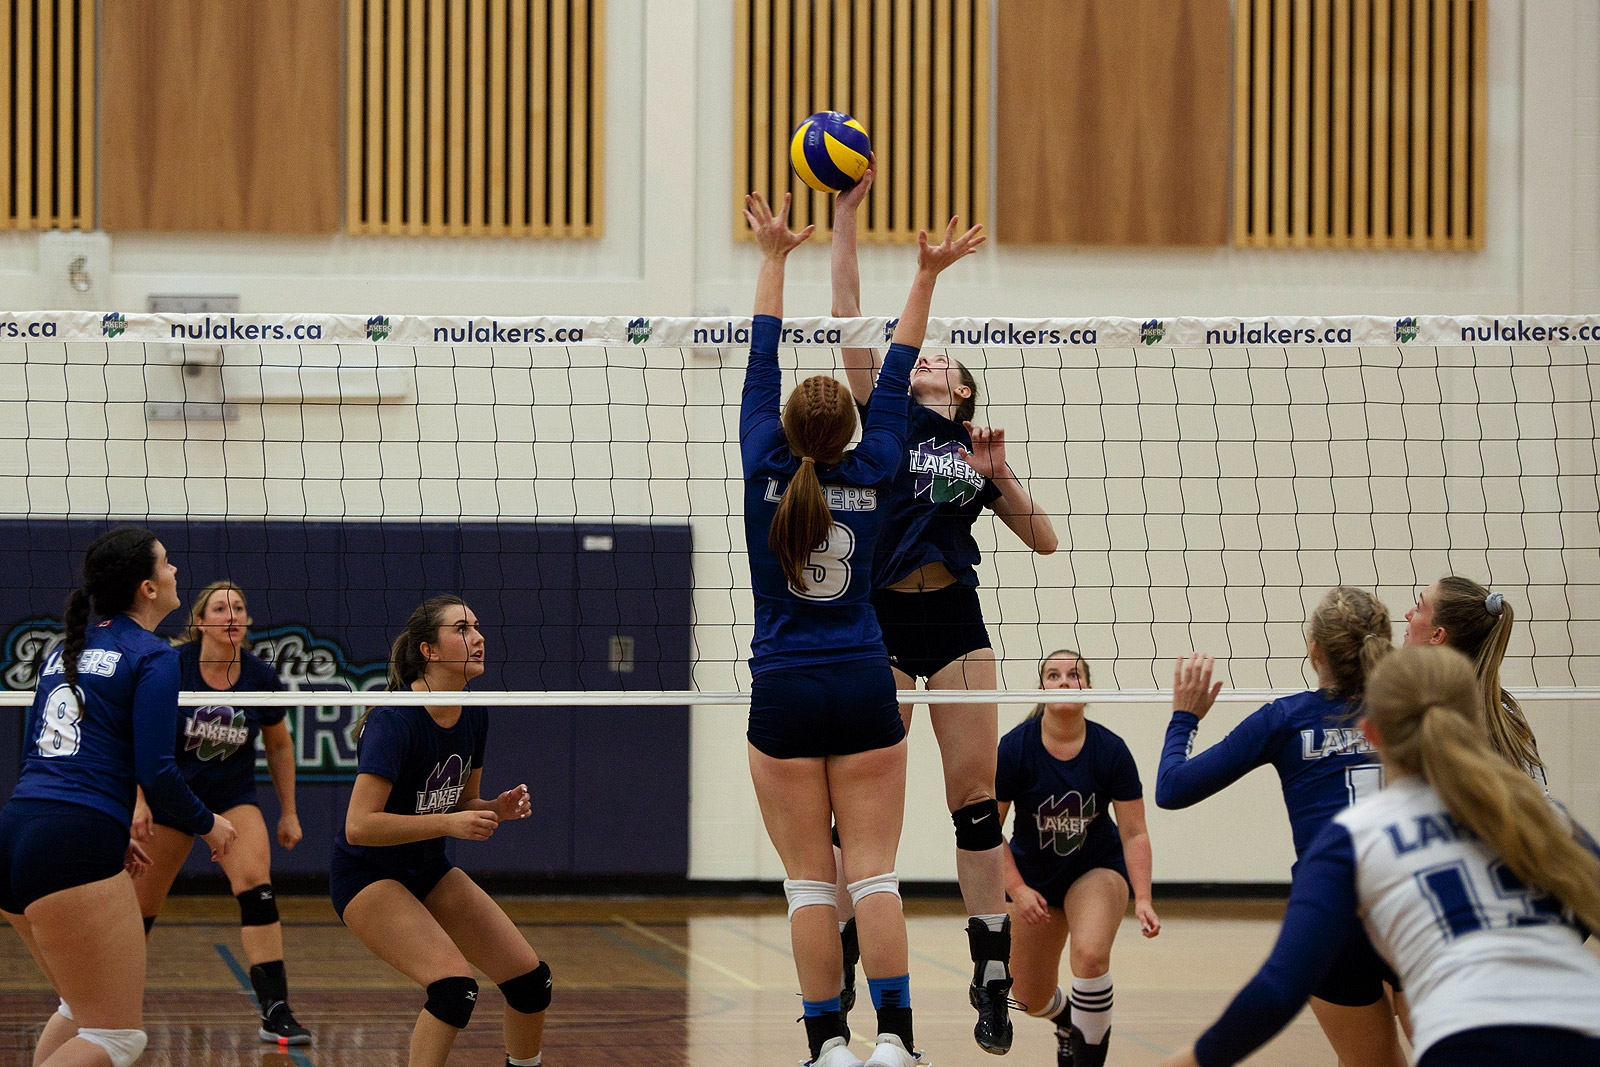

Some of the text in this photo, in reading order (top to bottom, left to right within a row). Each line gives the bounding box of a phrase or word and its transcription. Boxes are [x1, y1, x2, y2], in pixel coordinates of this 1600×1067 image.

[171, 318, 322, 340] nulakers.ca
[433, 321, 584, 343] nulakers.ca
[693, 321, 842, 344] nulars.ca
[951, 322, 1097, 344] nulakers.ca
[1206, 322, 1352, 345] nulakers.ca
[763, 476, 877, 512] LERS
[787, 520, 855, 601] 3
[36, 683, 86, 757] 8
[184, 716, 249, 745] LAKERS
